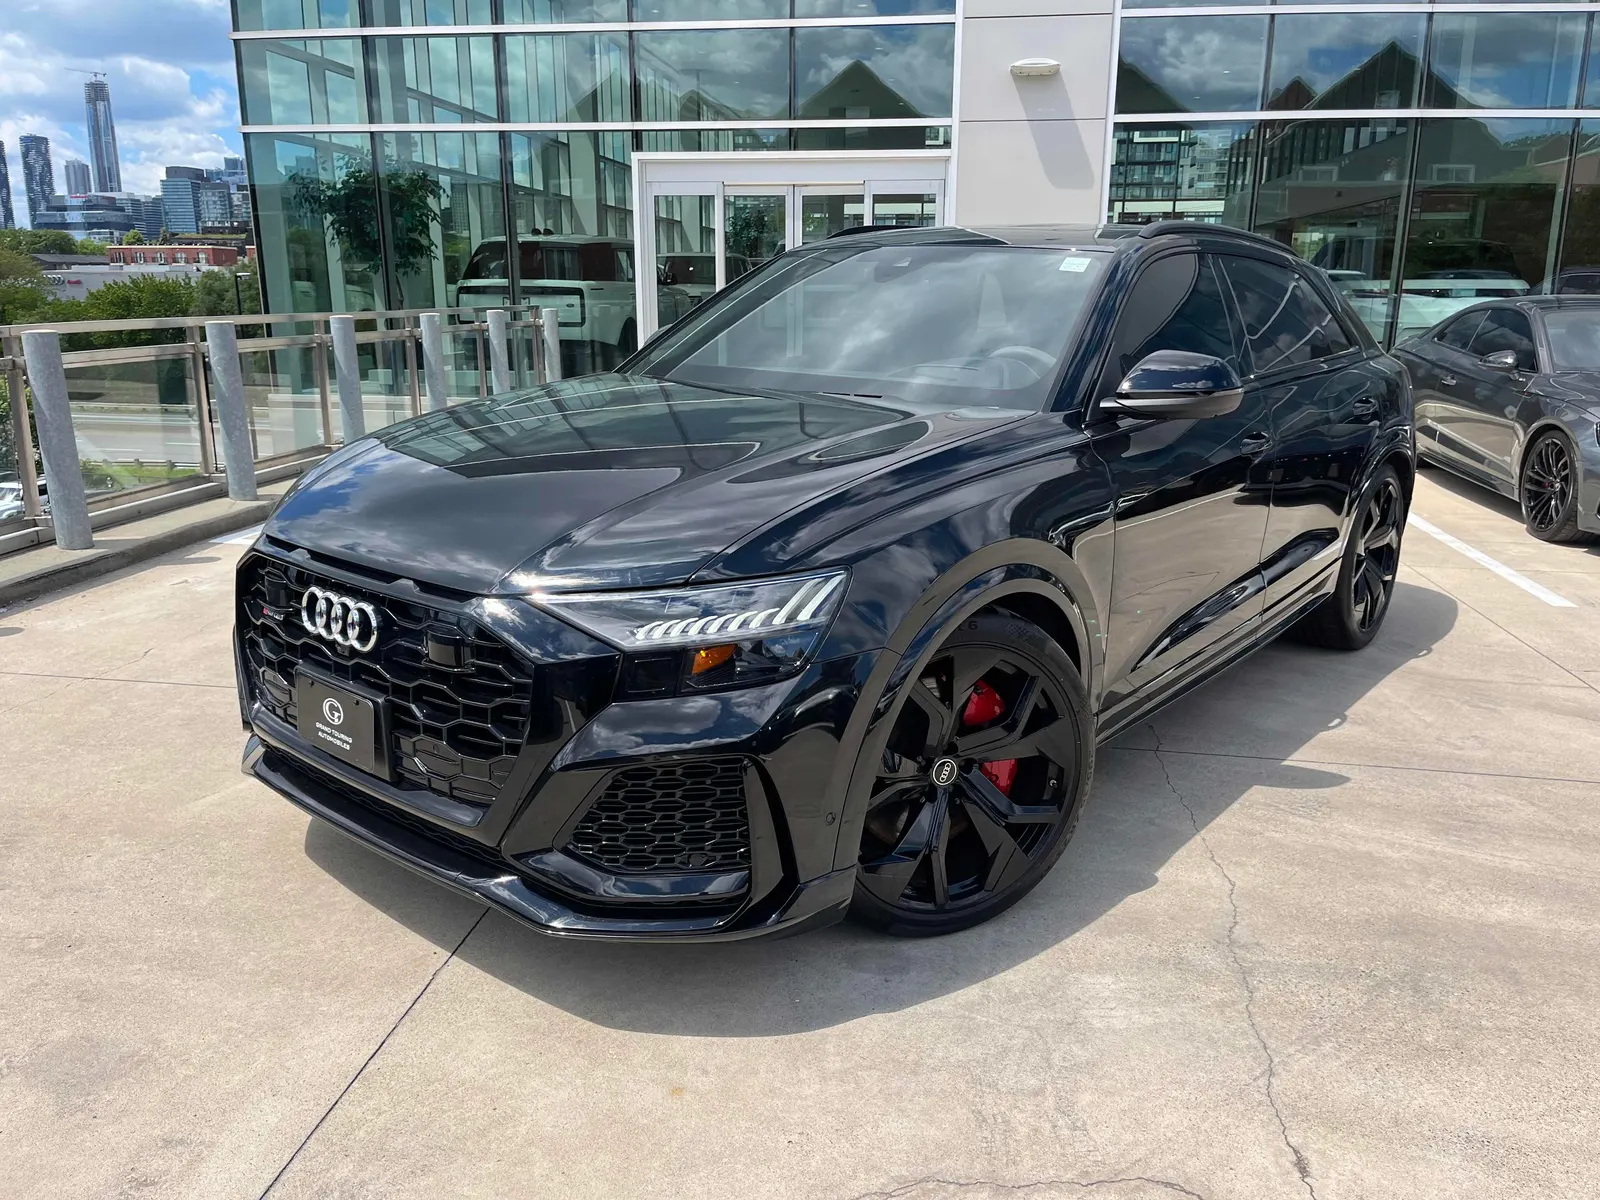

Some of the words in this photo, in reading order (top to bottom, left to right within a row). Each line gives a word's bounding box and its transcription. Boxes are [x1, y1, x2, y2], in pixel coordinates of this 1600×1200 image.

[315, 722, 332, 734] GRAND
[331, 728, 353, 744] TOURING
[318, 731, 351, 751] AUTOMOBILES
